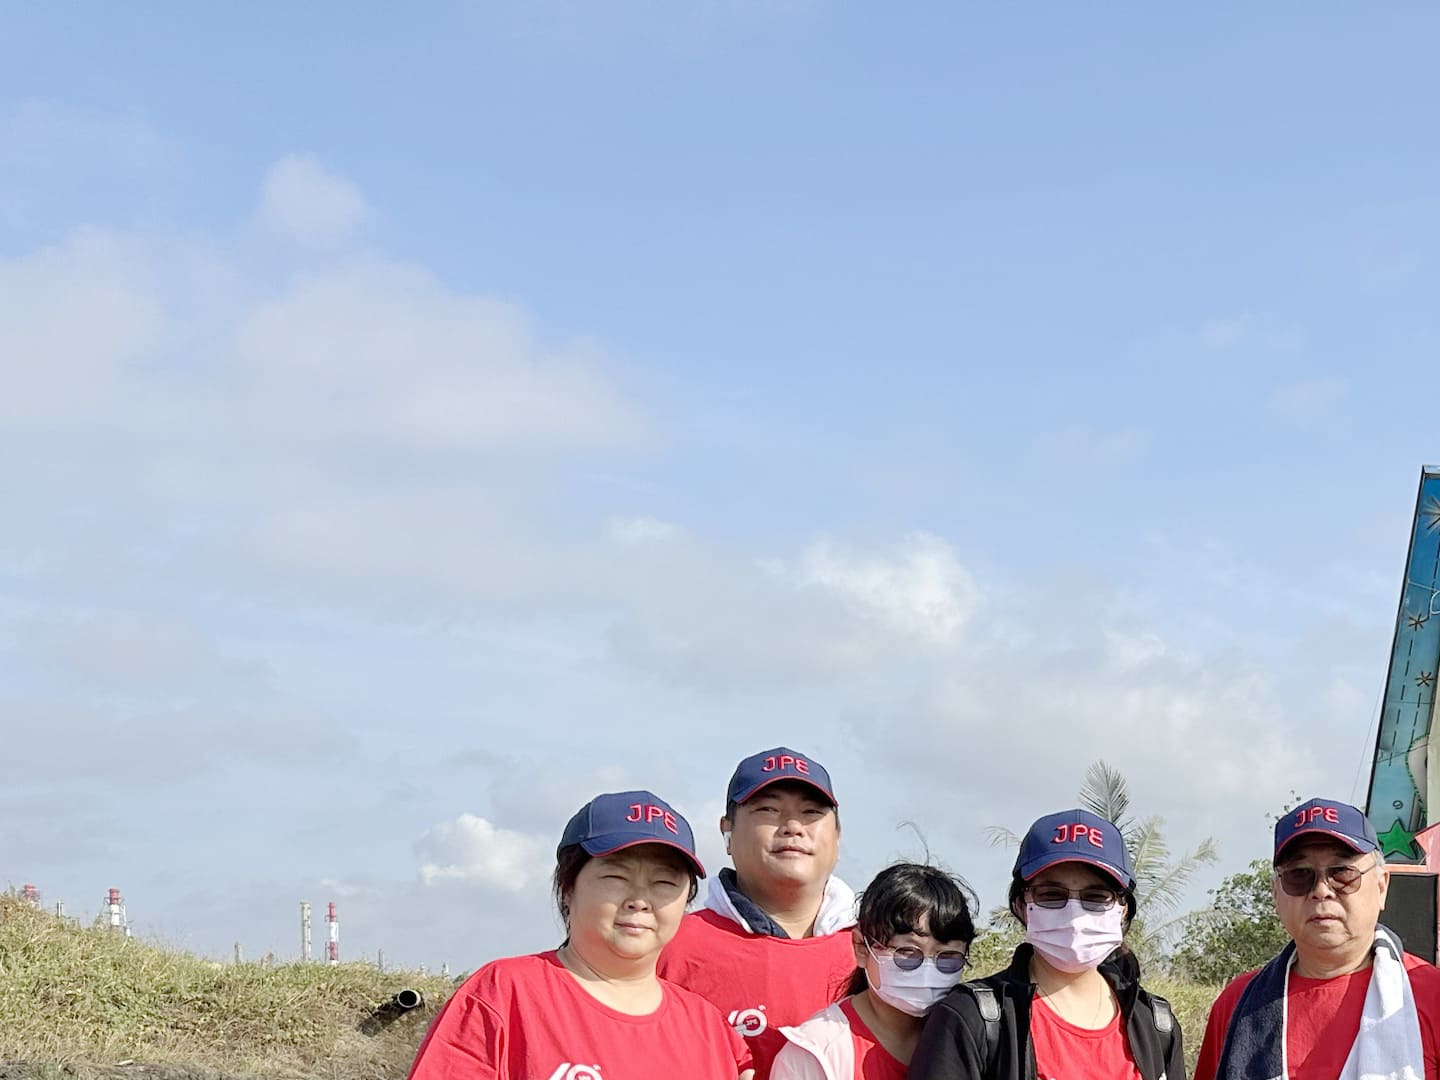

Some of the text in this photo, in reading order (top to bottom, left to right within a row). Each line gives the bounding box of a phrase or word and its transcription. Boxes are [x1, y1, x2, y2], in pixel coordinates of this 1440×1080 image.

[762, 755, 810, 775] JPE
[625, 804, 679, 835] JPE
[1294, 806, 1340, 828] JPE
[1053, 823, 1104, 848] JPE
